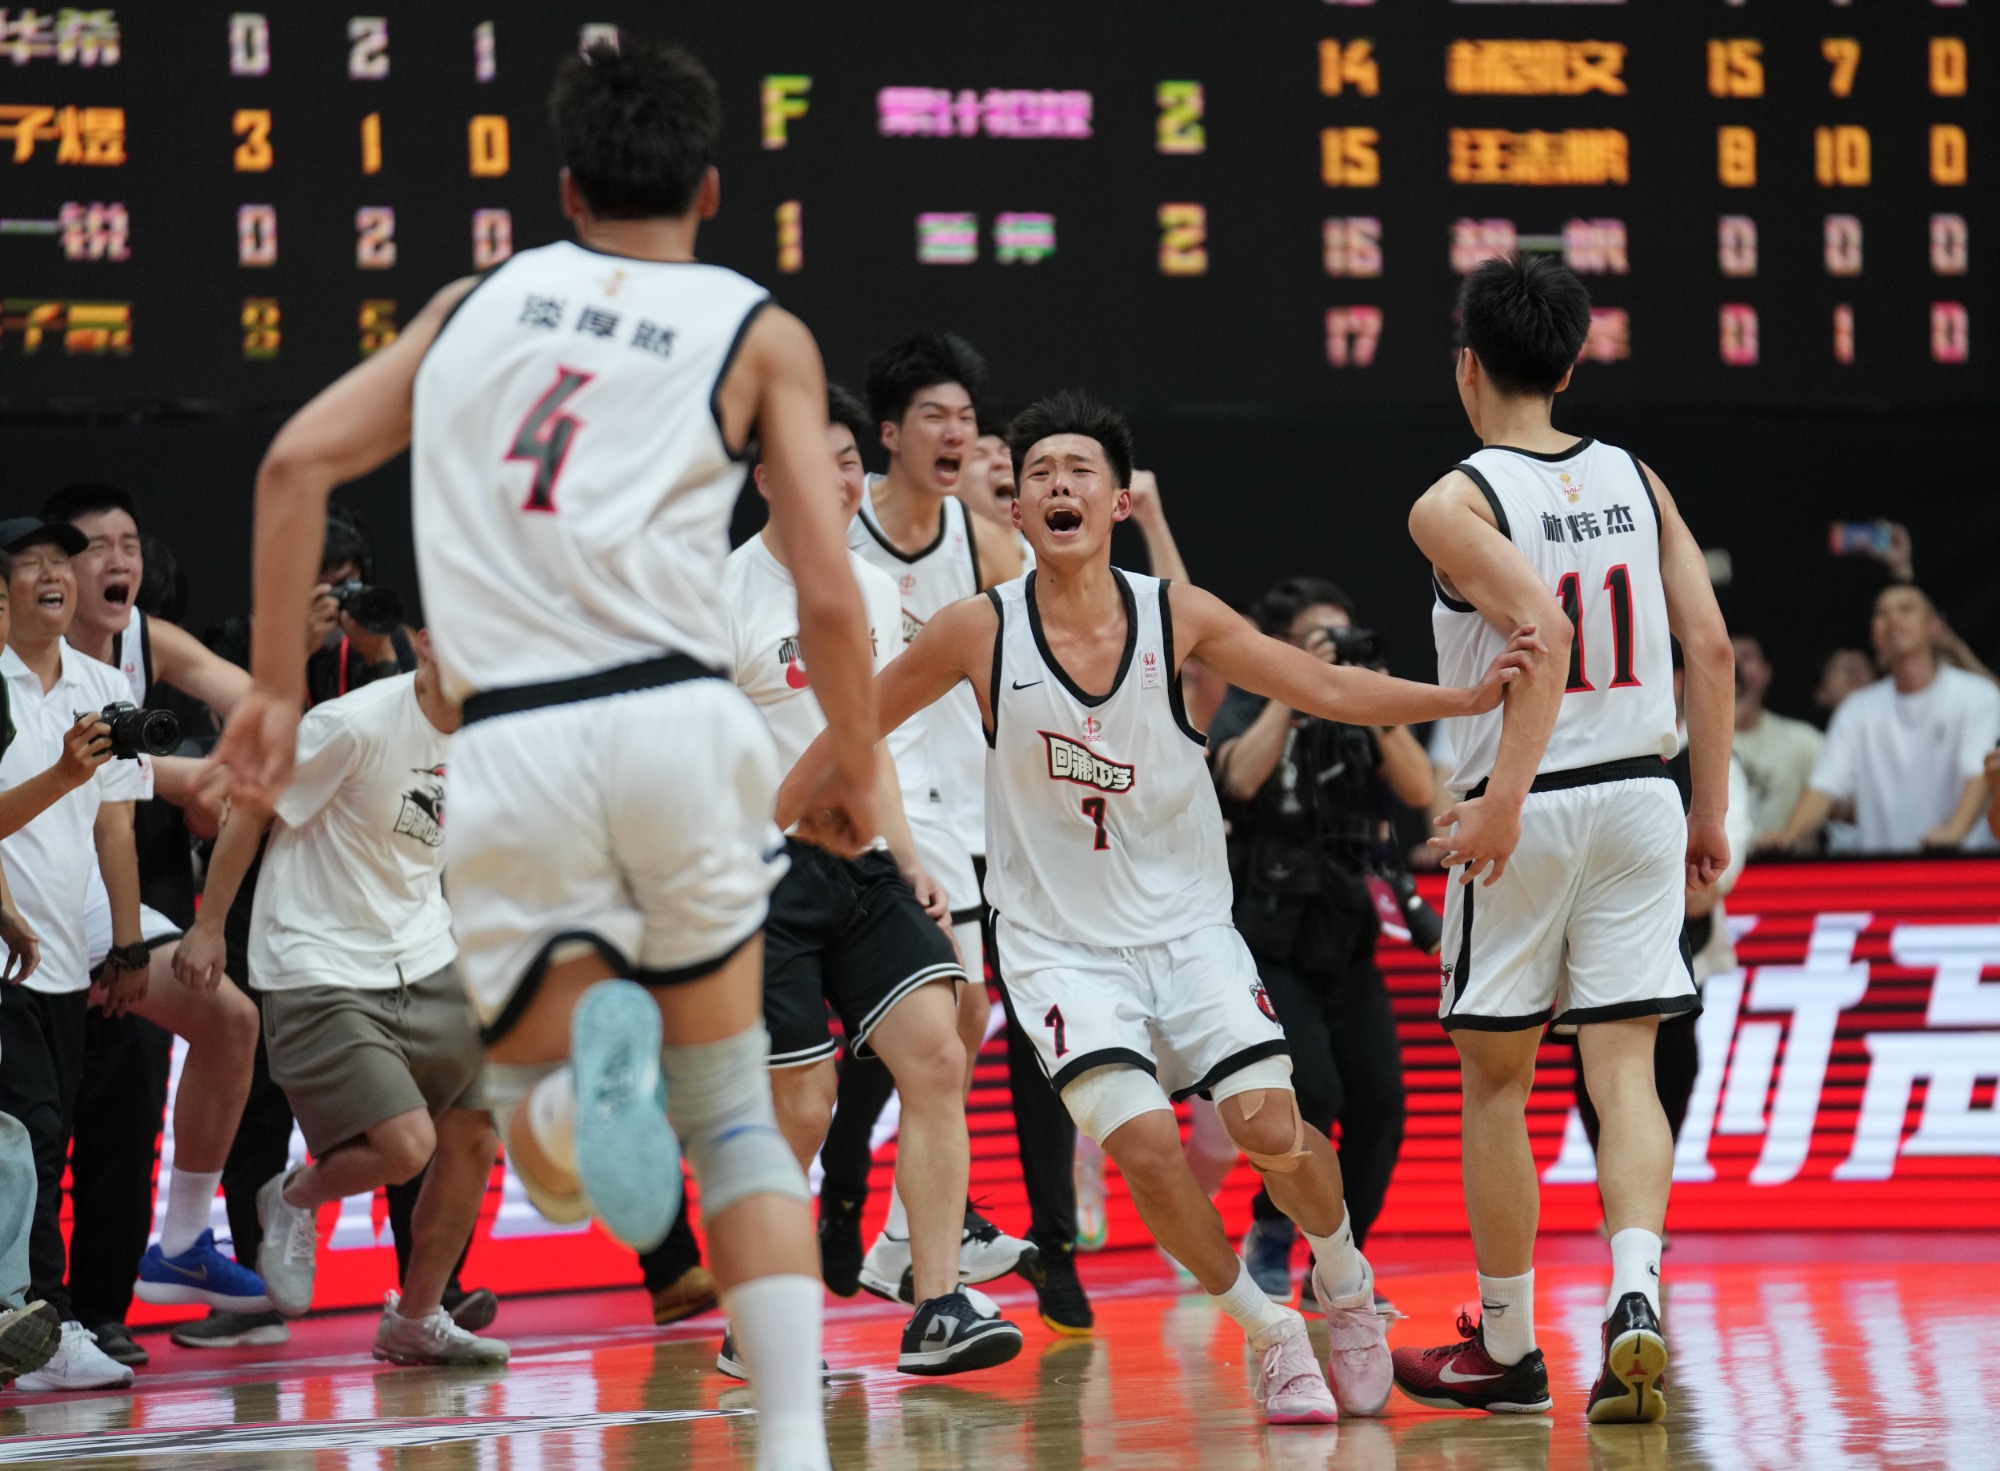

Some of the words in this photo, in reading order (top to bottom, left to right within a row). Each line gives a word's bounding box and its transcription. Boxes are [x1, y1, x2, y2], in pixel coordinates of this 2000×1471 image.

[229, 13, 271, 76] 0
[348, 17, 390, 79] 2
[475, 22, 496, 82] 1
[1319, 38, 1380, 97] 14
[1707, 38, 1765, 98] 15
[1821, 38, 1861, 97] 7
[1929, 37, 1968, 97] 0
[233, 108, 274, 172] 3
[361, 112, 383, 175] 1
[468, 114, 511, 178] 0
[760, 74, 812, 150] F
[1156, 80, 1207, 154] 2
[1321, 126, 1382, 188] 15
[1717, 125, 1757, 188] 8
[1814, 125, 1872, 187] 10
[1929, 124, 1968, 186] 0
[238, 203, 278, 267] 0
[355, 206, 396, 269] 2
[473, 208, 512, 271] 0
[775, 200, 804, 273] 1
[1157, 202, 1208, 276] 2
[1718, 215, 1758, 277] 0
[1824, 215, 1863, 276] 0
[1930, 214, 1968, 275] 0
[1720, 303, 1759, 365] 0
[1833, 304, 1855, 364] 1
[1931, 301, 1968, 363] 0
[504, 364, 598, 514] 4
[1540, 504, 1636, 543] 林炜杰
[1556, 563, 1643, 694] 11
[1049, 738, 1134, 791] 回浦中学
[1081, 796, 1110, 851] 7
